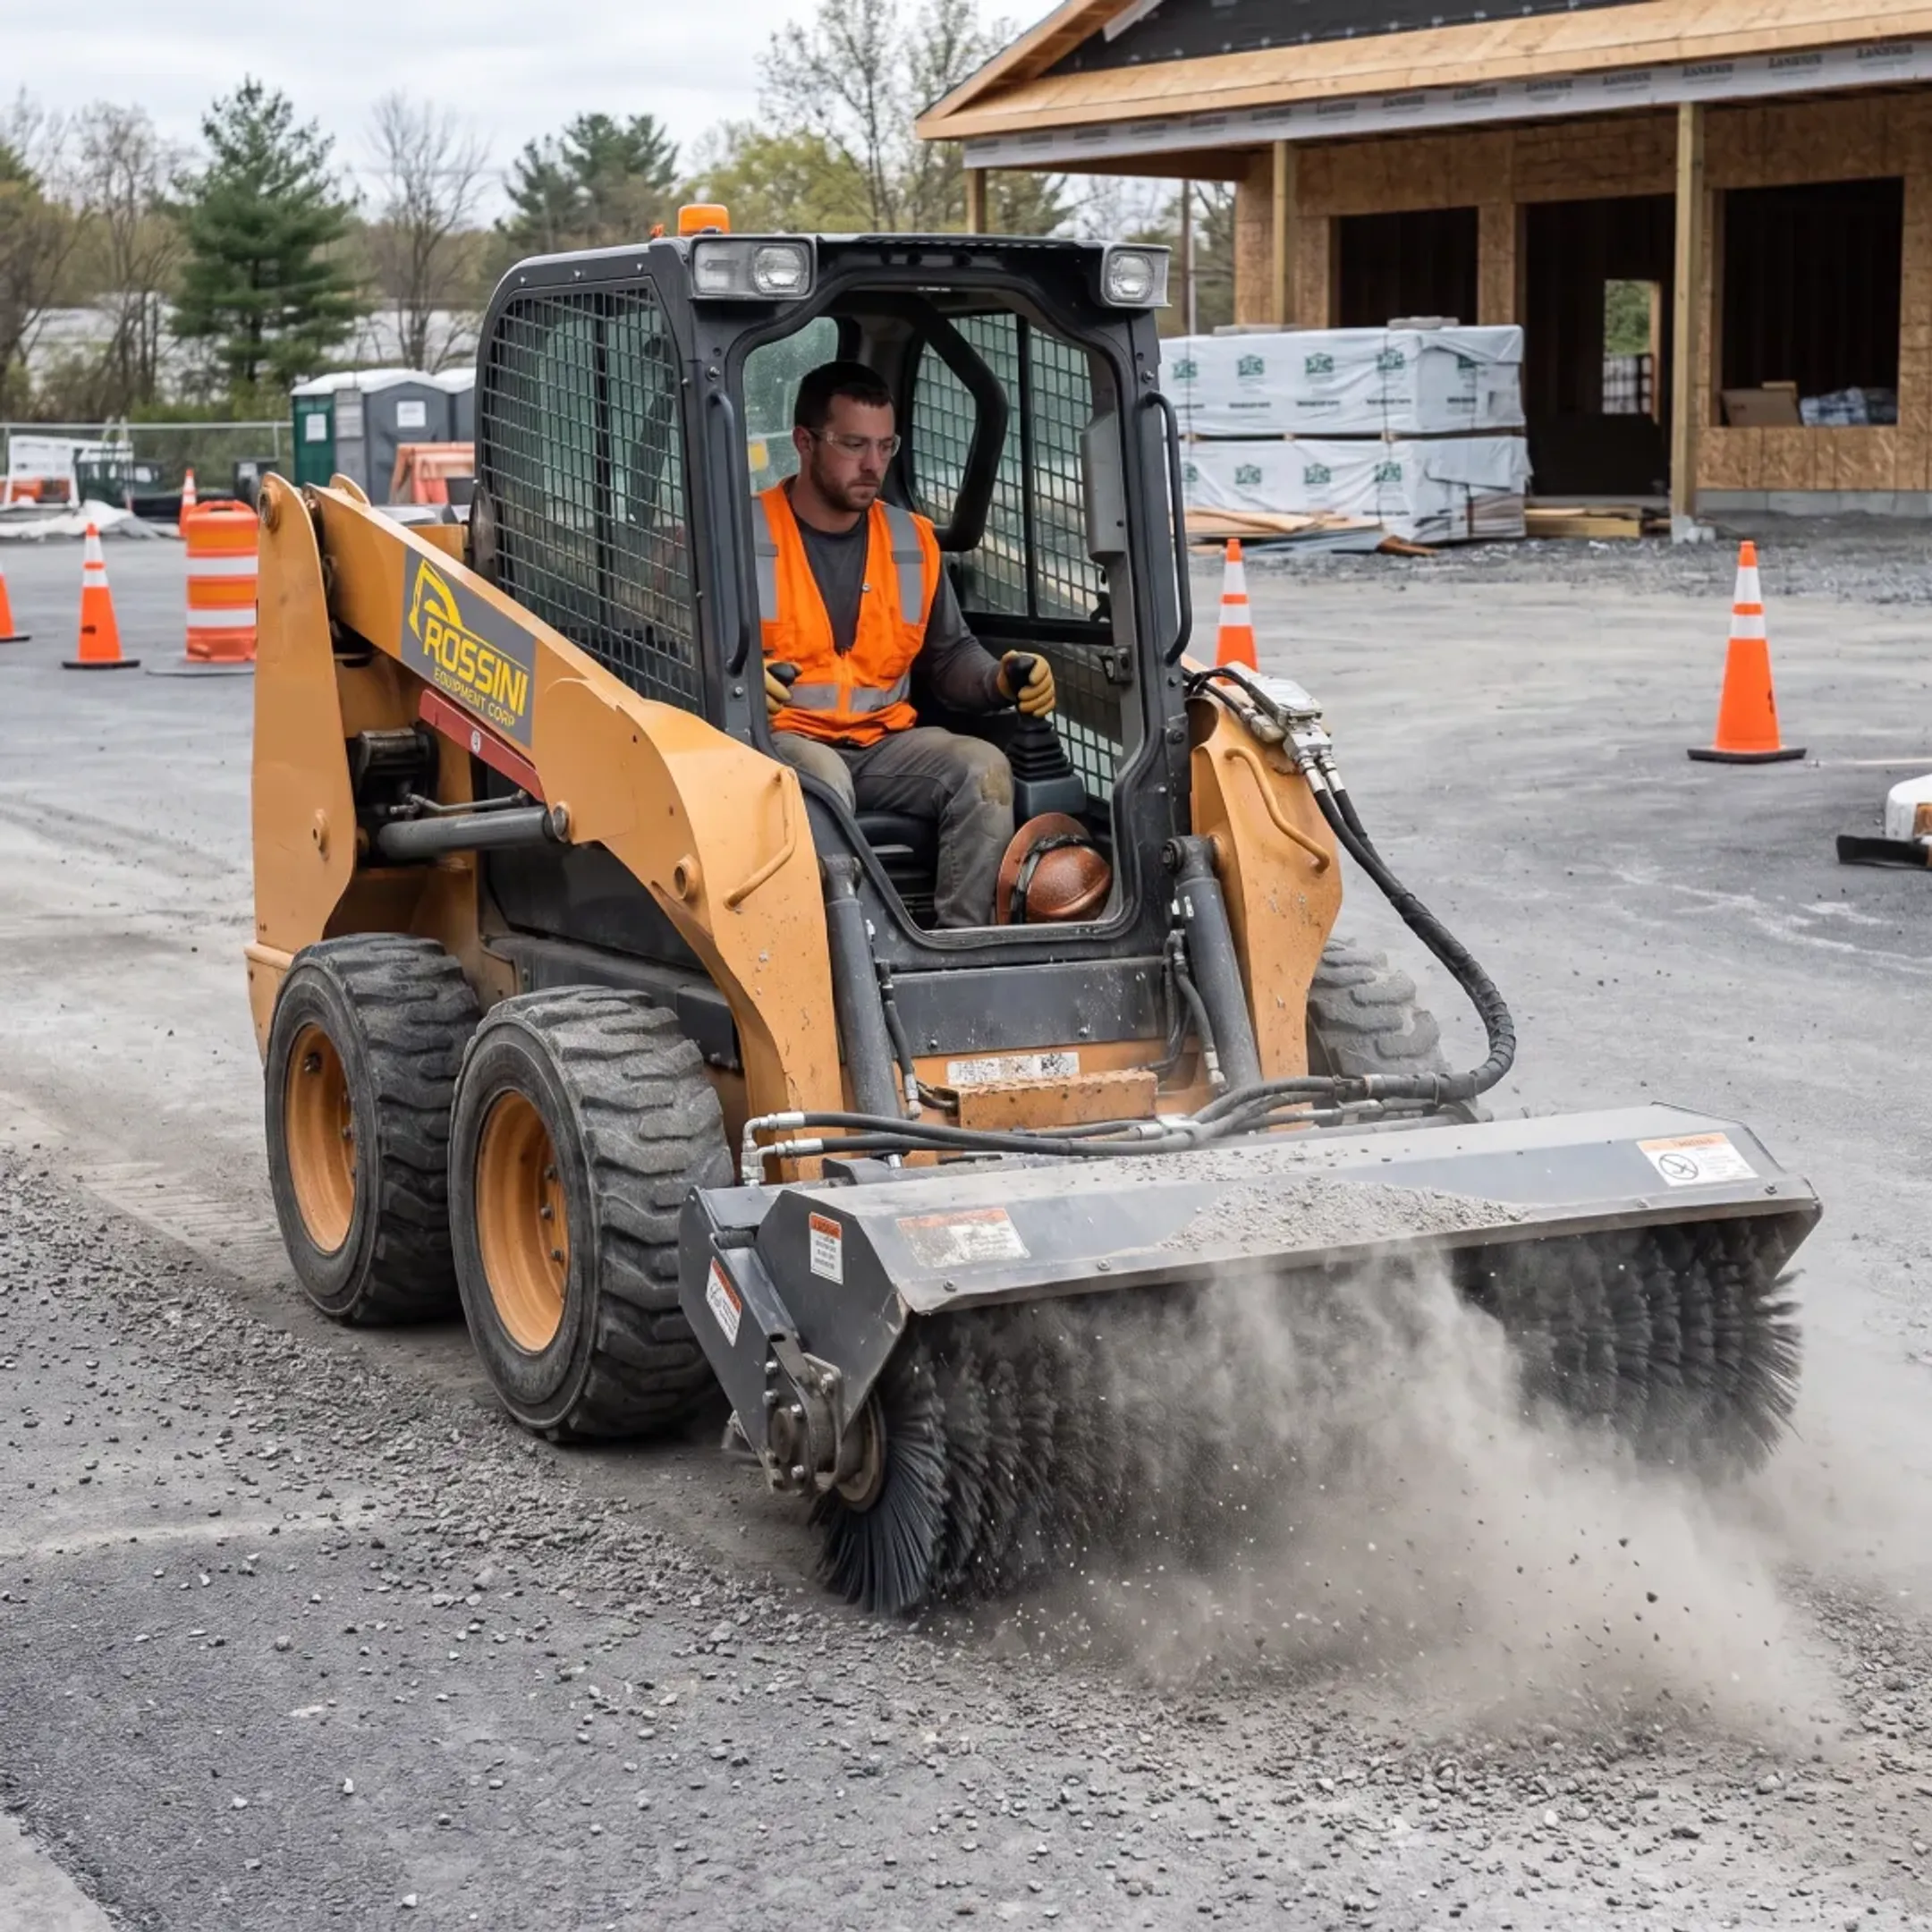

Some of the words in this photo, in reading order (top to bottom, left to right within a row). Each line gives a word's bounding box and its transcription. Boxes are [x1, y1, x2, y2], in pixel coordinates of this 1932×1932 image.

[424, 617, 530, 716] ROSSINI
[434, 667, 487, 711] EQUIPMENT
[488, 701, 516, 727] CORP
